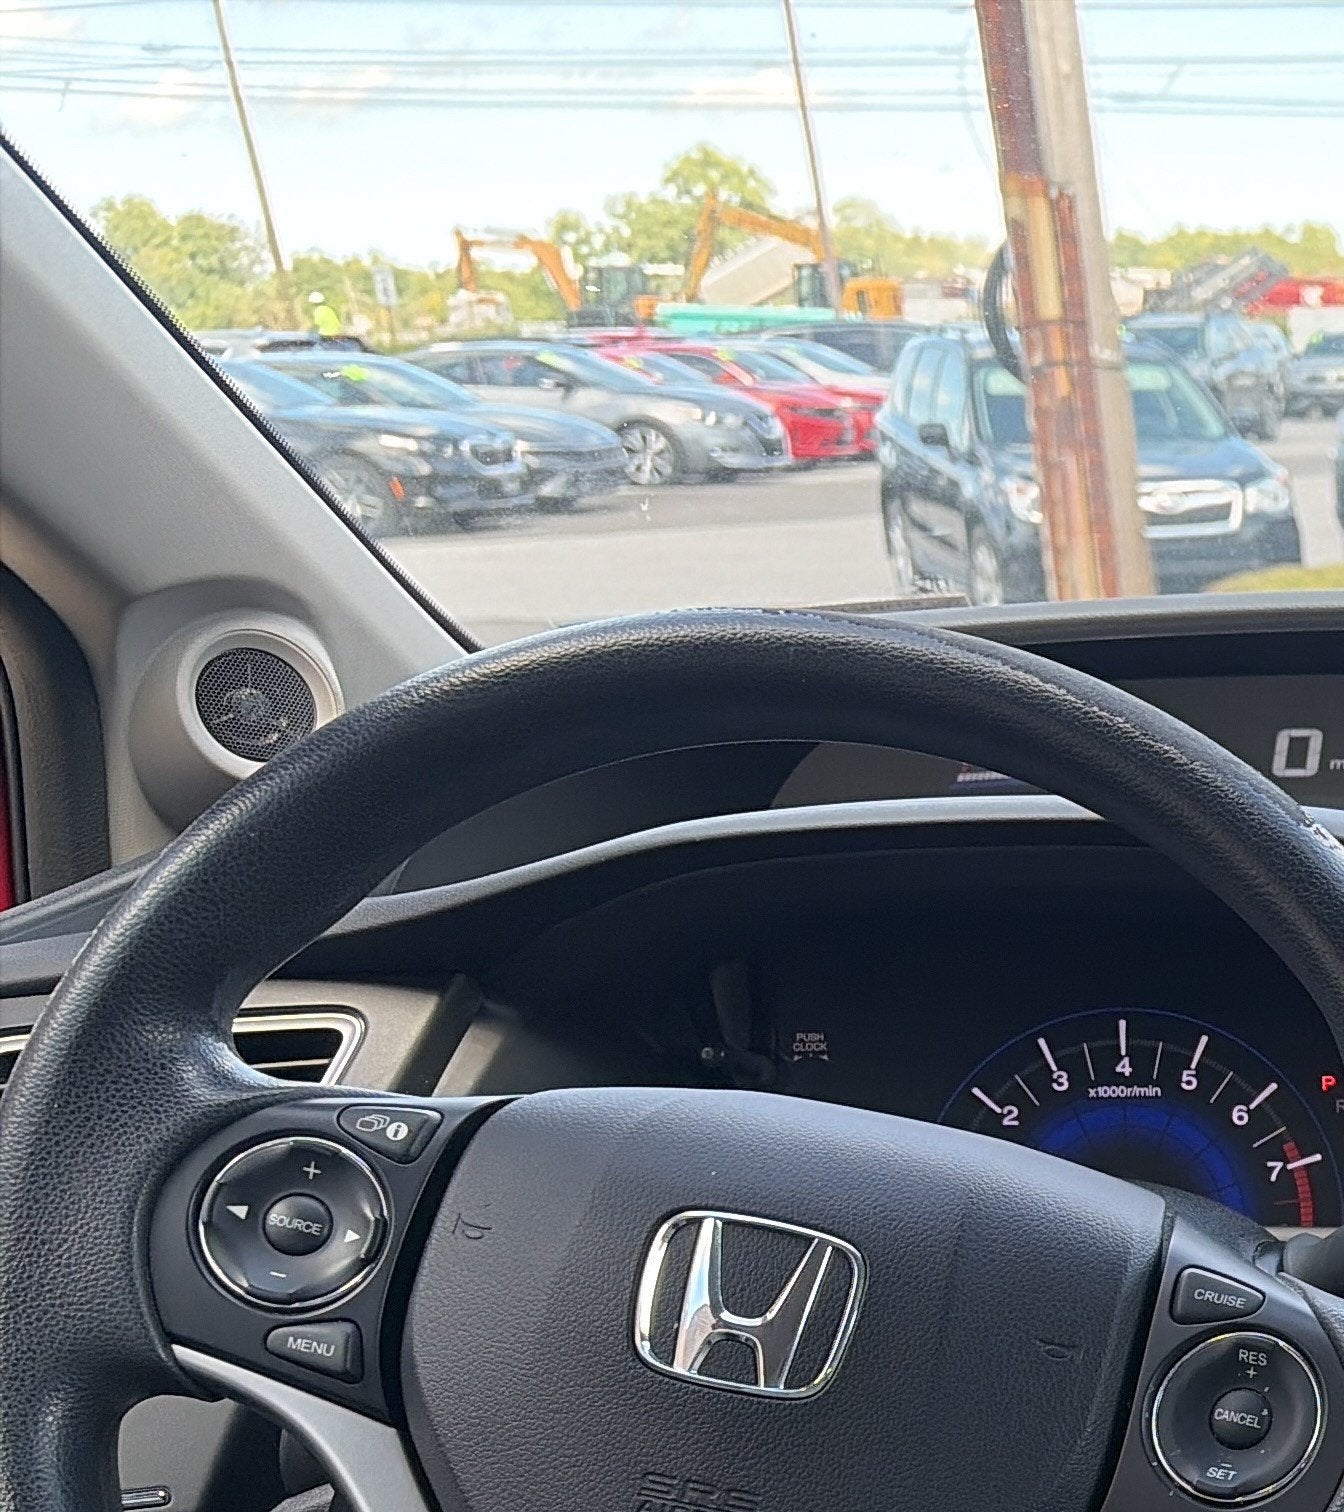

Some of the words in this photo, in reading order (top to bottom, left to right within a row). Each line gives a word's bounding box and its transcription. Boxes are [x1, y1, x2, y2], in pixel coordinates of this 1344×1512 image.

[1271, 728, 1323, 777] 0
[793, 1042, 827, 1051] CLOCK
[796, 1033, 824, 1041] PUSH
[1115, 1057, 1132, 1077] 4
[1052, 1070, 1069, 1091] 3
[1180, 1069, 1198, 1091] 5
[1321, 1075, 1337, 1092] P
[1088, 1085, 1162, 1098] x1000r/min
[1002, 1105, 1019, 1126] 2
[1231, 1104, 1249, 1126] 6
[1266, 1161, 1284, 1182] 7
[268, 1213, 323, 1236] SOURCE
[1194, 1288, 1246, 1309] CRUISE
[287, 1336, 335, 1357] MENU
[1238, 1349, 1267, 1366] RES
[1214, 1408, 1261, 1429] CANCEL
[1206, 1466, 1237, 1481] SET
